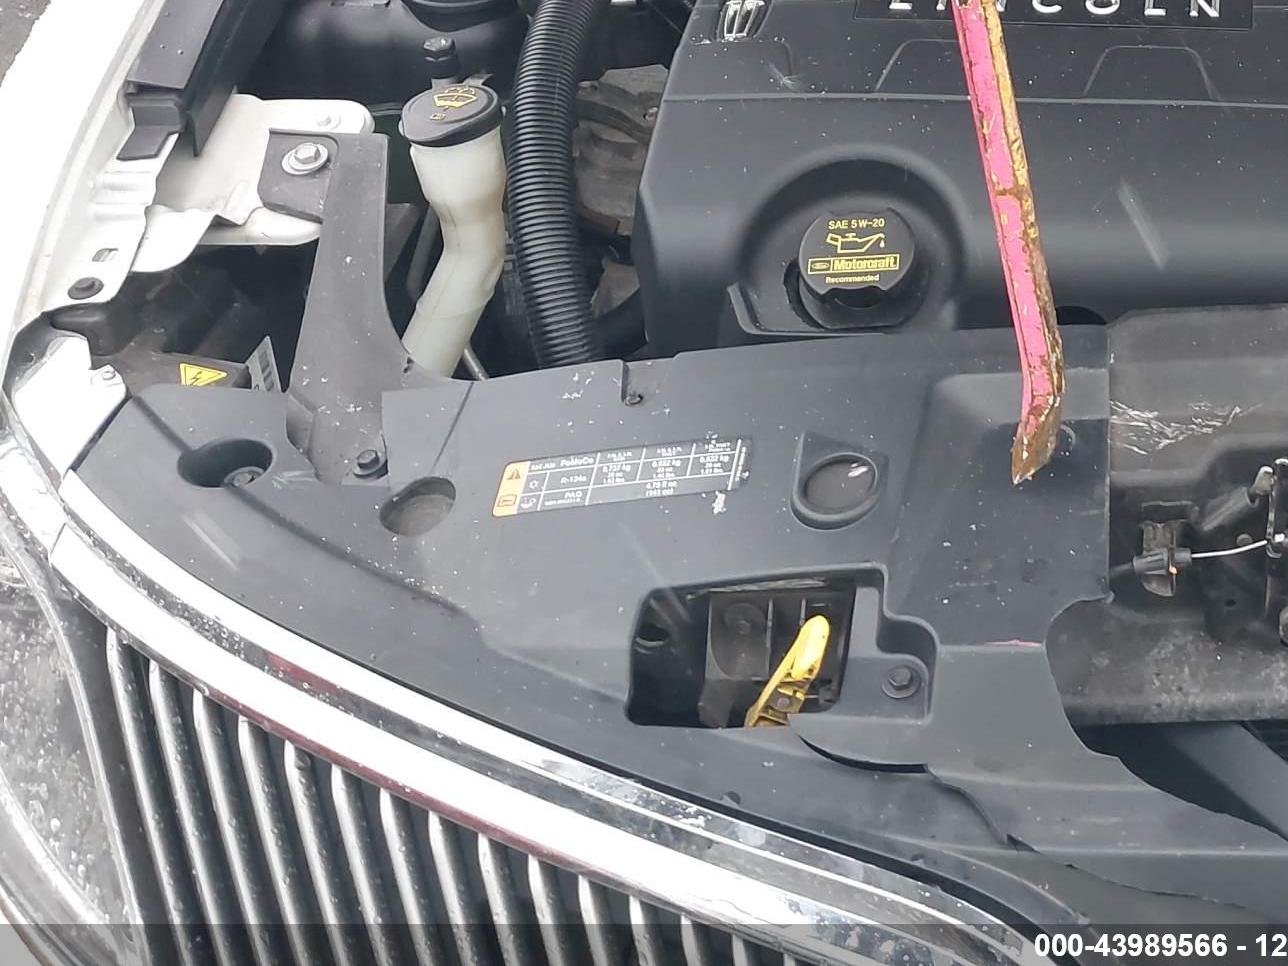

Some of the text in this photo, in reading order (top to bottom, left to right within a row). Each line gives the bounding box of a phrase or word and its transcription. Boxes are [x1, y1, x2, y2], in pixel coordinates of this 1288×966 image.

[828, 218, 885, 230] SAE 5W-20
[833, 257, 897, 271] Motorcraft
[825, 274, 880, 284] Recommended
